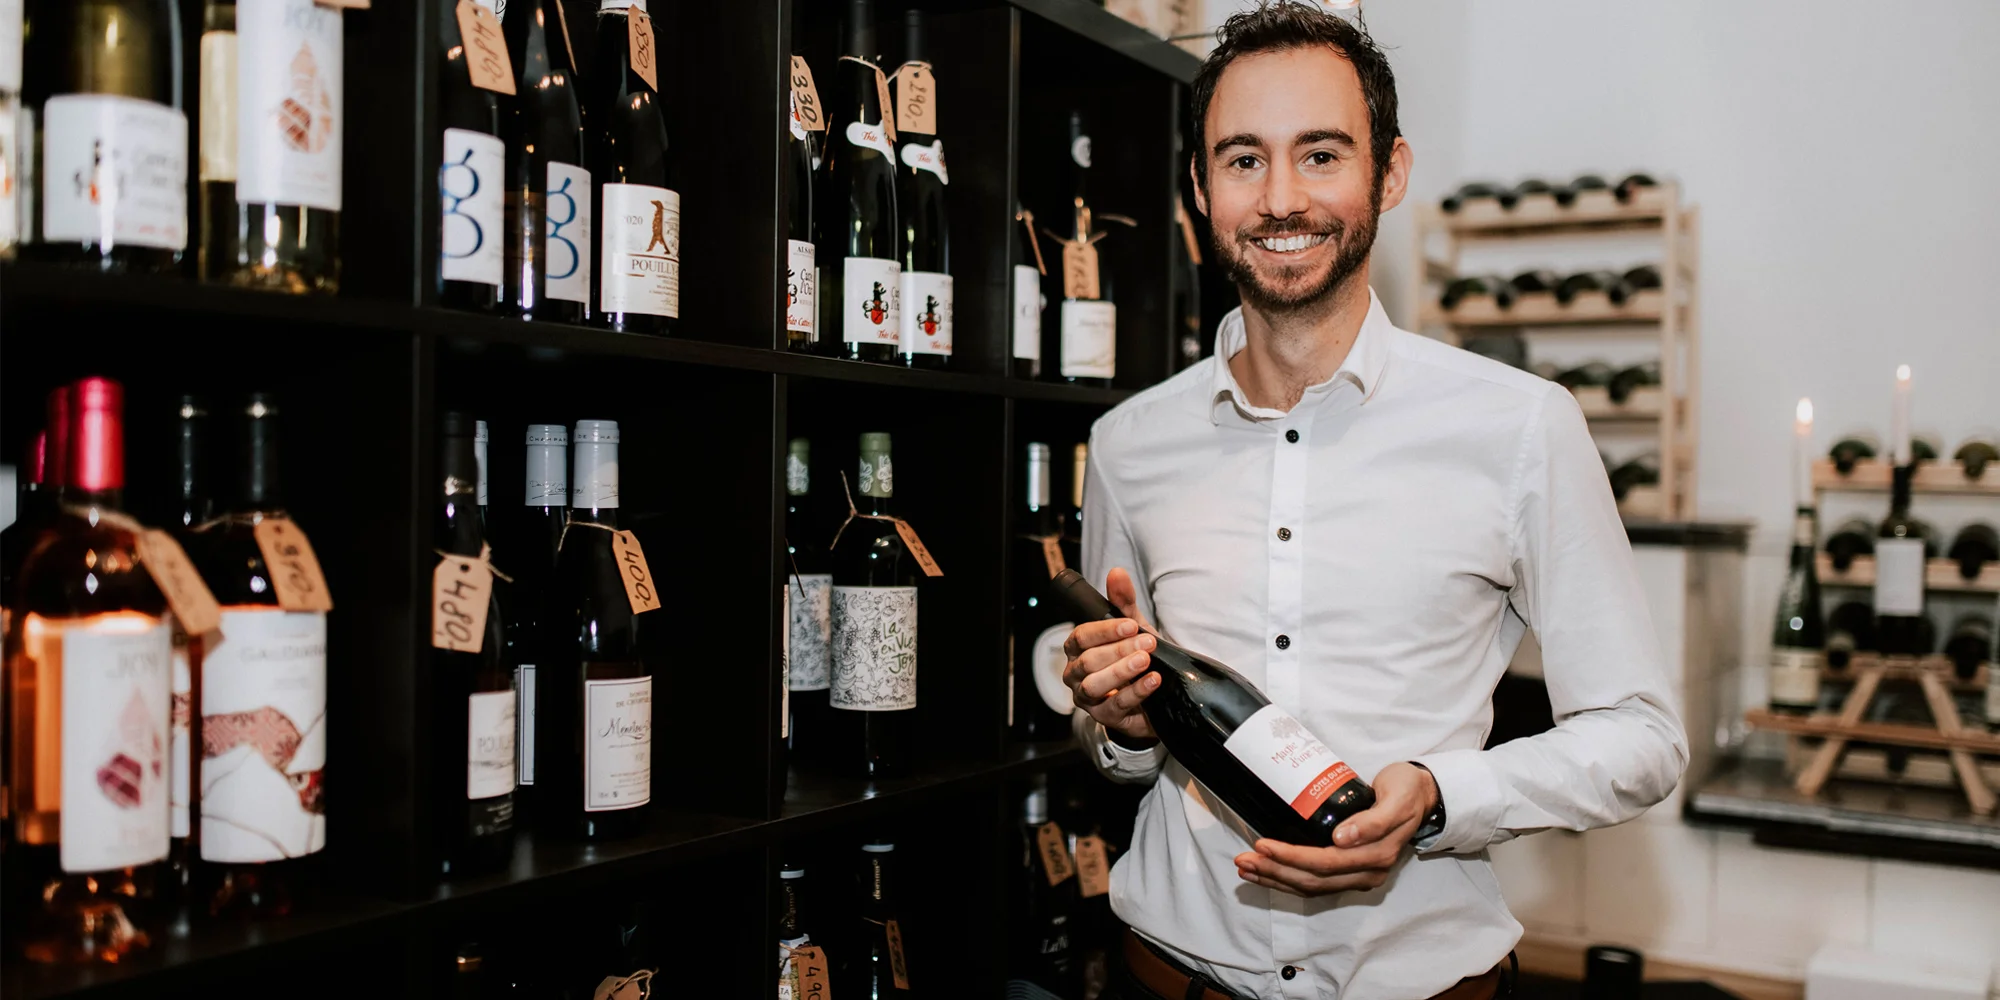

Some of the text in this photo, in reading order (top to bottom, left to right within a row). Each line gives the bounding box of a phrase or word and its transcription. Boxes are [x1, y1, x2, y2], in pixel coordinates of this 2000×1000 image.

[792, 74, 817, 130] 330,-
[906, 82, 928, 129] 290,-
[624, 214, 644, 226] 020
[624, 551, 651, 606] 400,-
[441, 579, 478, 651] 480,-
[883, 622, 901, 640] La
[1271, 742, 1297, 764] Magie
[1309, 776, 1331, 797] CÔTES
